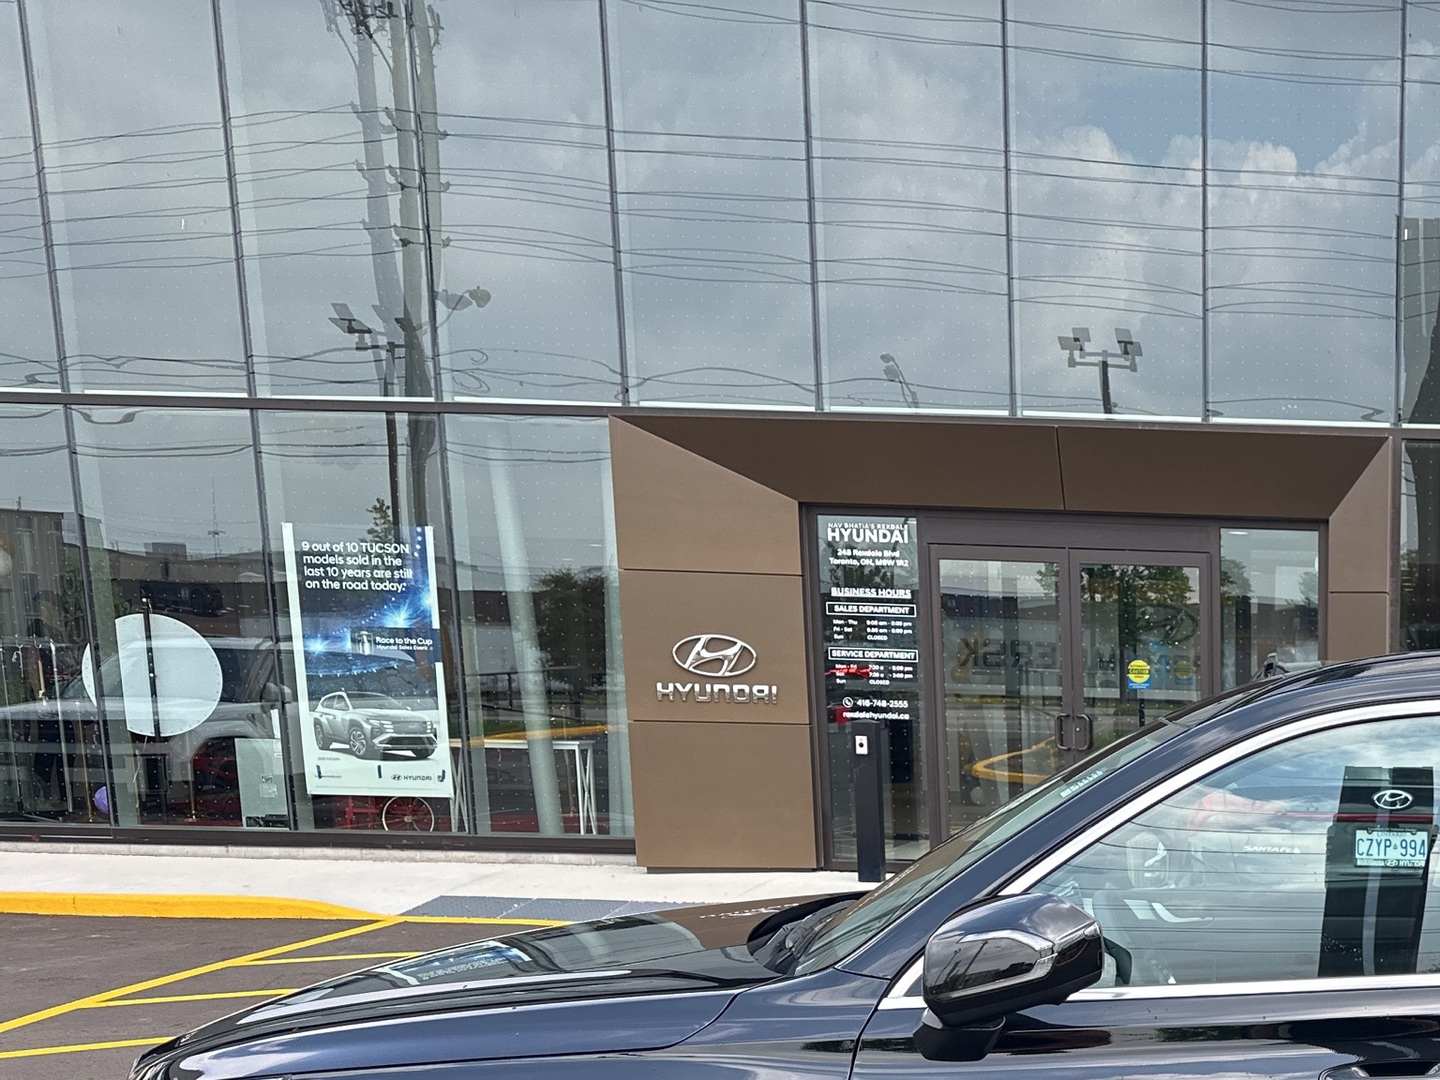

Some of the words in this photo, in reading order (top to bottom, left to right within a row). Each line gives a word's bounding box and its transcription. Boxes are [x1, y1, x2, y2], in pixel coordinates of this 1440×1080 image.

[827, 527, 909, 544] HYUNDAI
[301, 541, 310, 551] 9
[311, 542, 331, 551] out
[332, 542, 344, 552] of
[345, 542, 359, 553] 10
[360, 543, 410, 554] TUCSON
[303, 554, 344, 565] models
[345, 555, 369, 566] sold
[371, 555, 382, 566] in
[383, 555, 402, 566] the
[304, 566, 325, 577] last
[326, 567, 339, 577] 10
[340, 568, 371, 579] years
[373, 569, 392, 578] are
[393, 568, 413, 579] still
[305, 580, 320, 589] on
[321, 579, 340, 590] the
[342, 579, 369, 590] road
[831, 587, 877, 596] BUSINESS
[878, 588, 912, 598] HOURS
[834, 604, 858, 613] SALES
[859, 605, 910, 614] DEPARTMENT
[375, 636, 394, 644] Race
[417, 637, 433, 647] Cup
[831, 650, 863, 658] SERVICE
[864, 650, 915, 659] DEPARTMENT
[656, 682, 778, 704] HYUNDAI
[1243, 845, 1279, 853] SANTA
[1357, 838, 1392, 857] CZYP
[1400, 839, 1426, 857] 994
